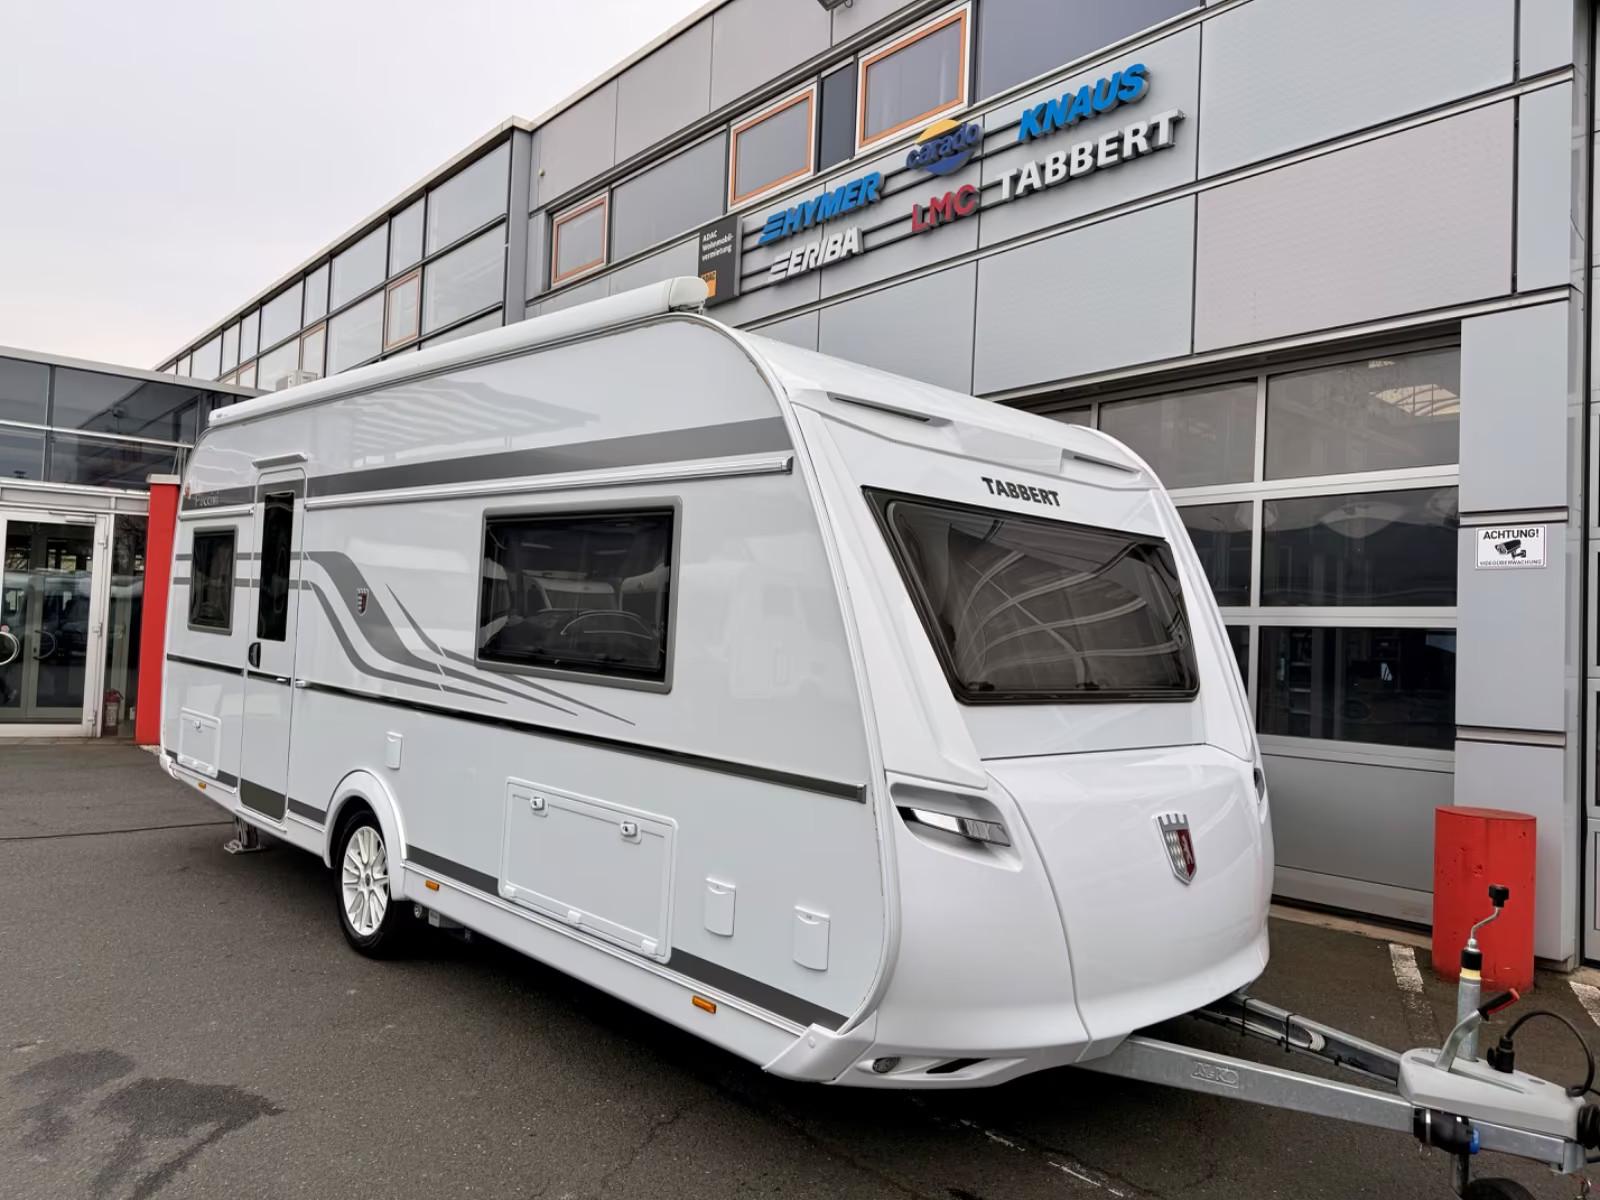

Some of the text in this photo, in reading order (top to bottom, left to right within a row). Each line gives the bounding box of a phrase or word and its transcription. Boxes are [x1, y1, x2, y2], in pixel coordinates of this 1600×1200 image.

[1017, 63, 1151, 142] KNAUS
[906, 121, 982, 170] carado
[999, 108, 1183, 201] TABBERT
[777, 171, 884, 238] HYMER
[911, 184, 978, 233] LMC
[703, 229, 718, 242] ADAC
[784, 226, 864, 277] ERIBA
[981, 476, 1060, 507] TABBERT
[1483, 528, 1540, 540] ACHTUNG!
